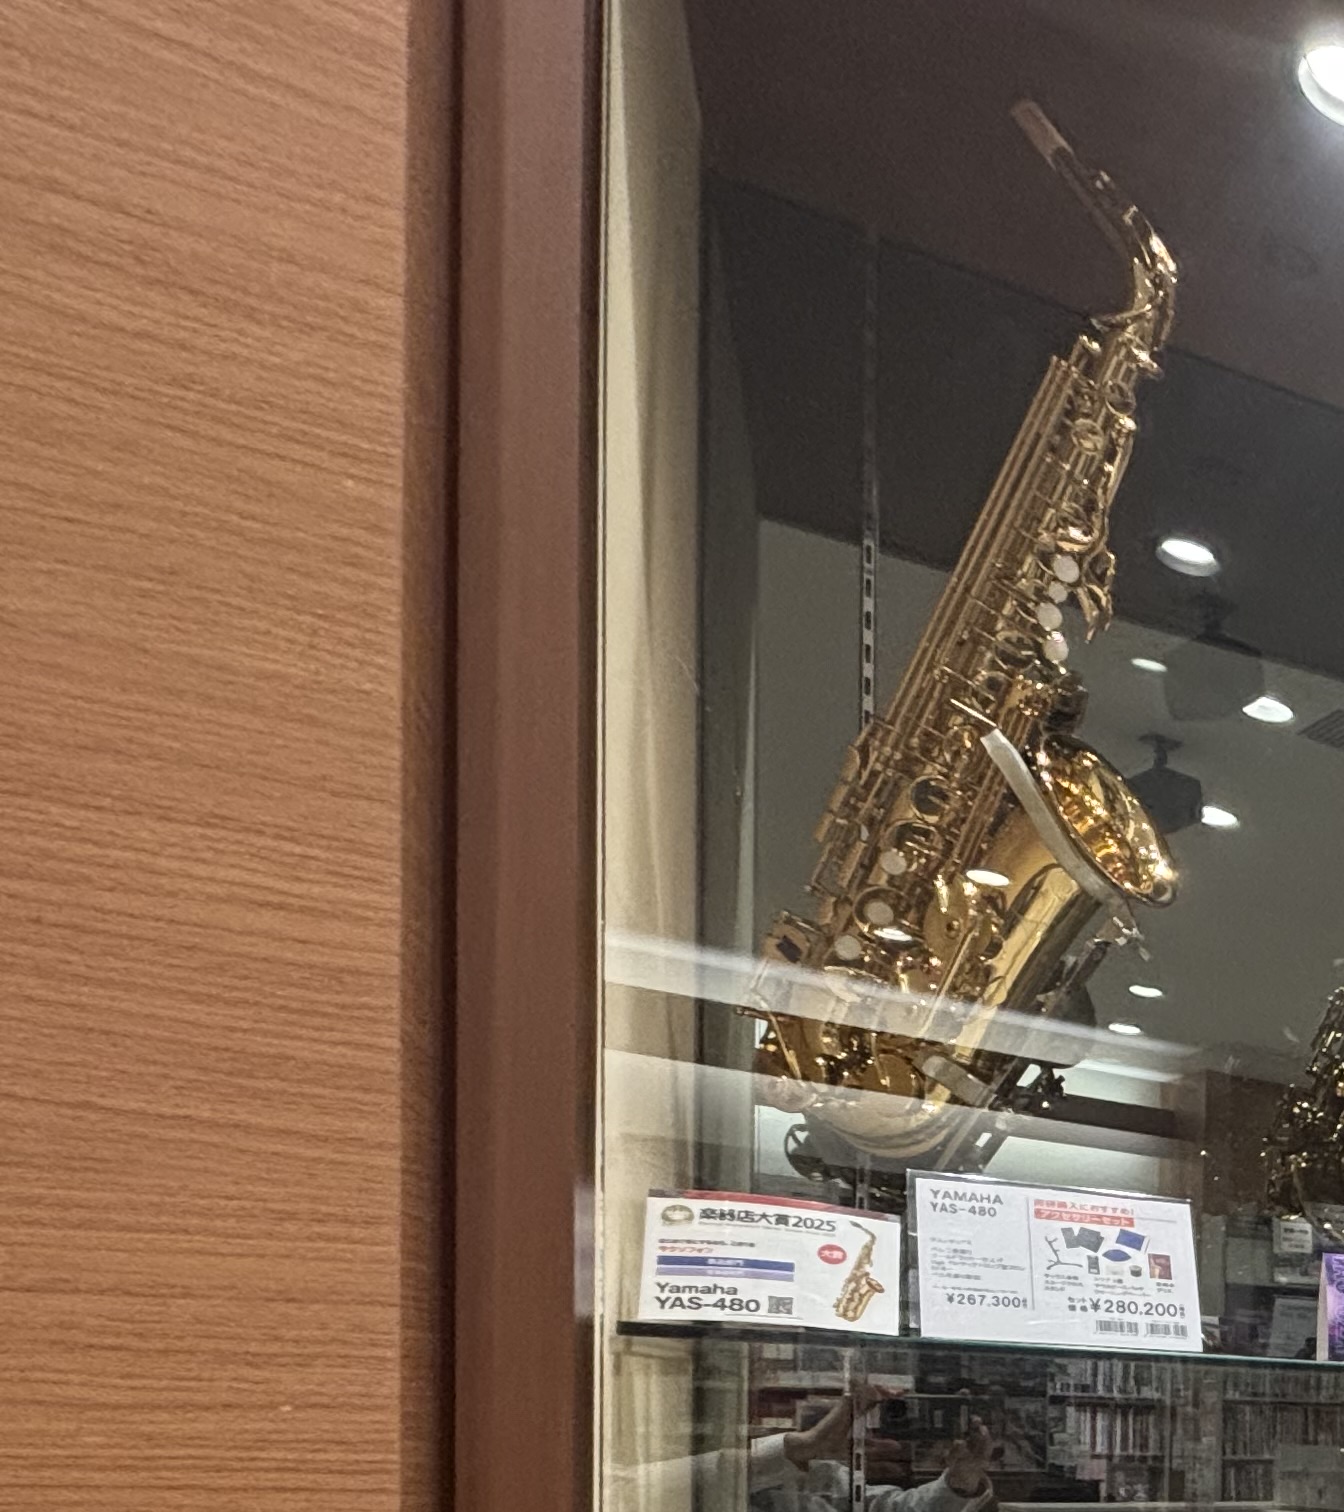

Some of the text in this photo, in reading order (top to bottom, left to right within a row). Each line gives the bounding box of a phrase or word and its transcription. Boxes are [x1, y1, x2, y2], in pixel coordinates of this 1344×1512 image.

[930, 1188, 1003, 1205] YAMAHA
[930, 1202, 997, 1218] YAS-480
[700, 1207, 836, 1233] 楽器店大賞2025
[656, 1282, 738, 1297] Yamaha
[655, 1296, 760, 1313] YAS-480
